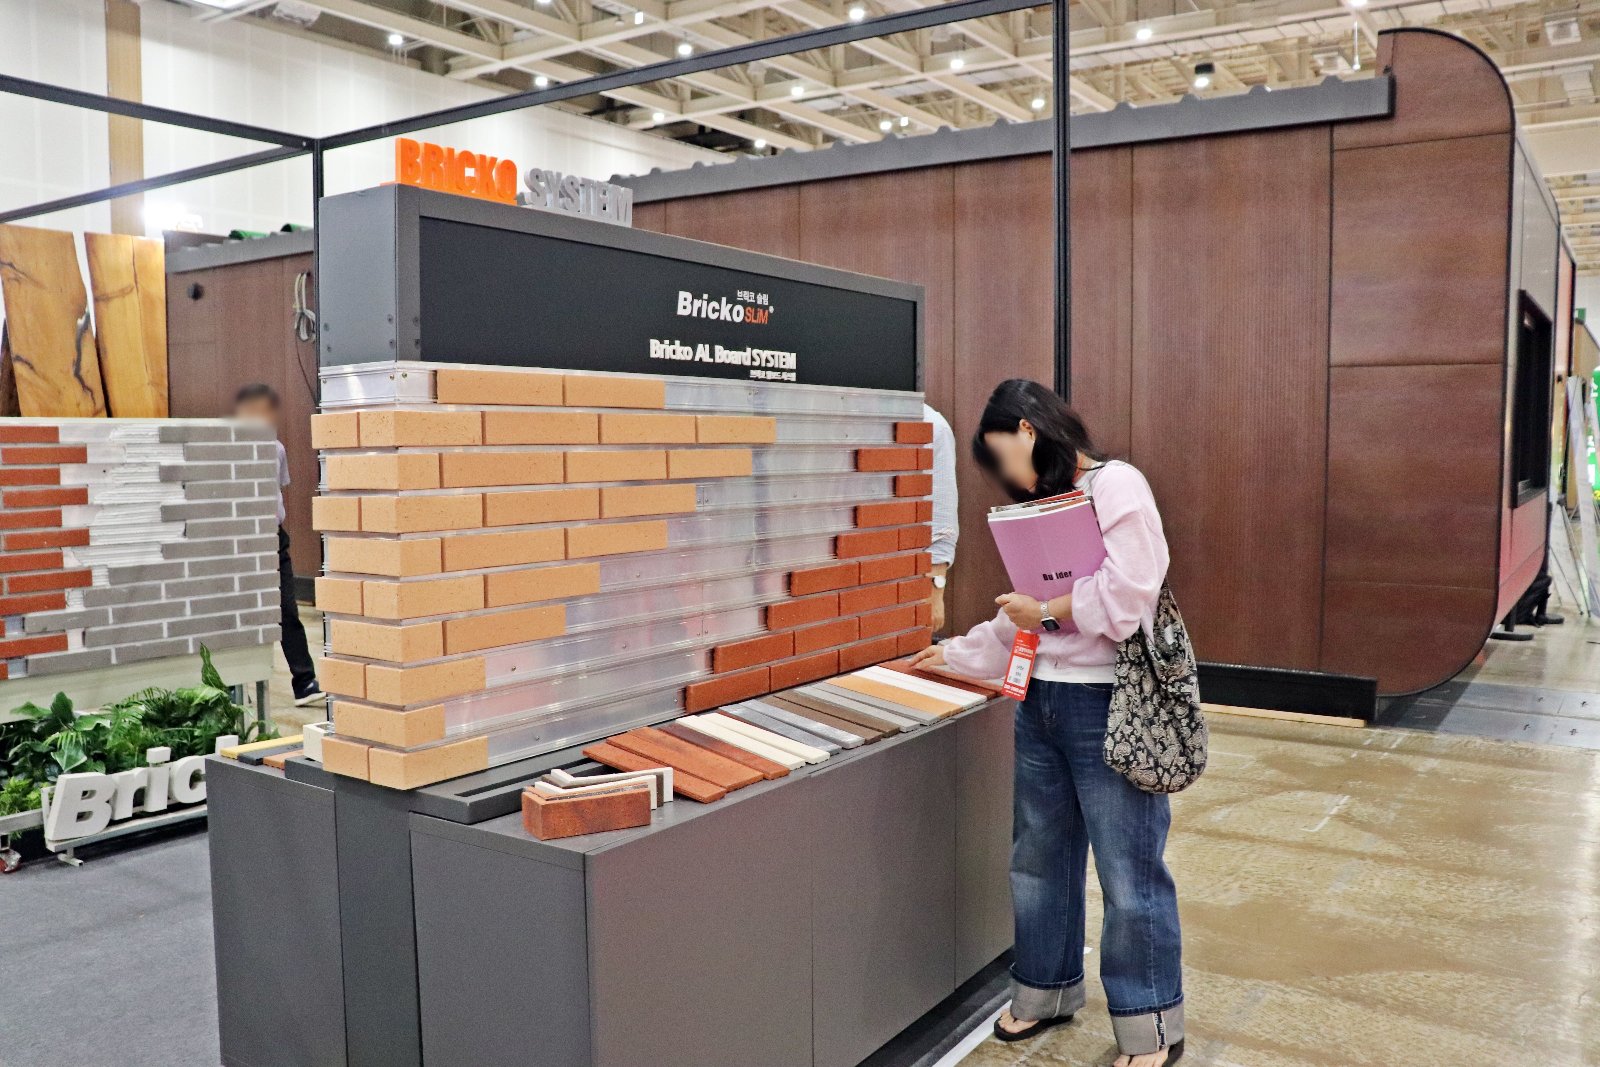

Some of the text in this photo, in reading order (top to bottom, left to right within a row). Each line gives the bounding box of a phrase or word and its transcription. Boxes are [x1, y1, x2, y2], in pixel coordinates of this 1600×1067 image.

[396, 138, 633, 228] BRICKO SYSTEM
[677, 291, 744, 322] Bricko
[650, 338, 693, 360] Bricko
[695, 344, 713, 363] AL
